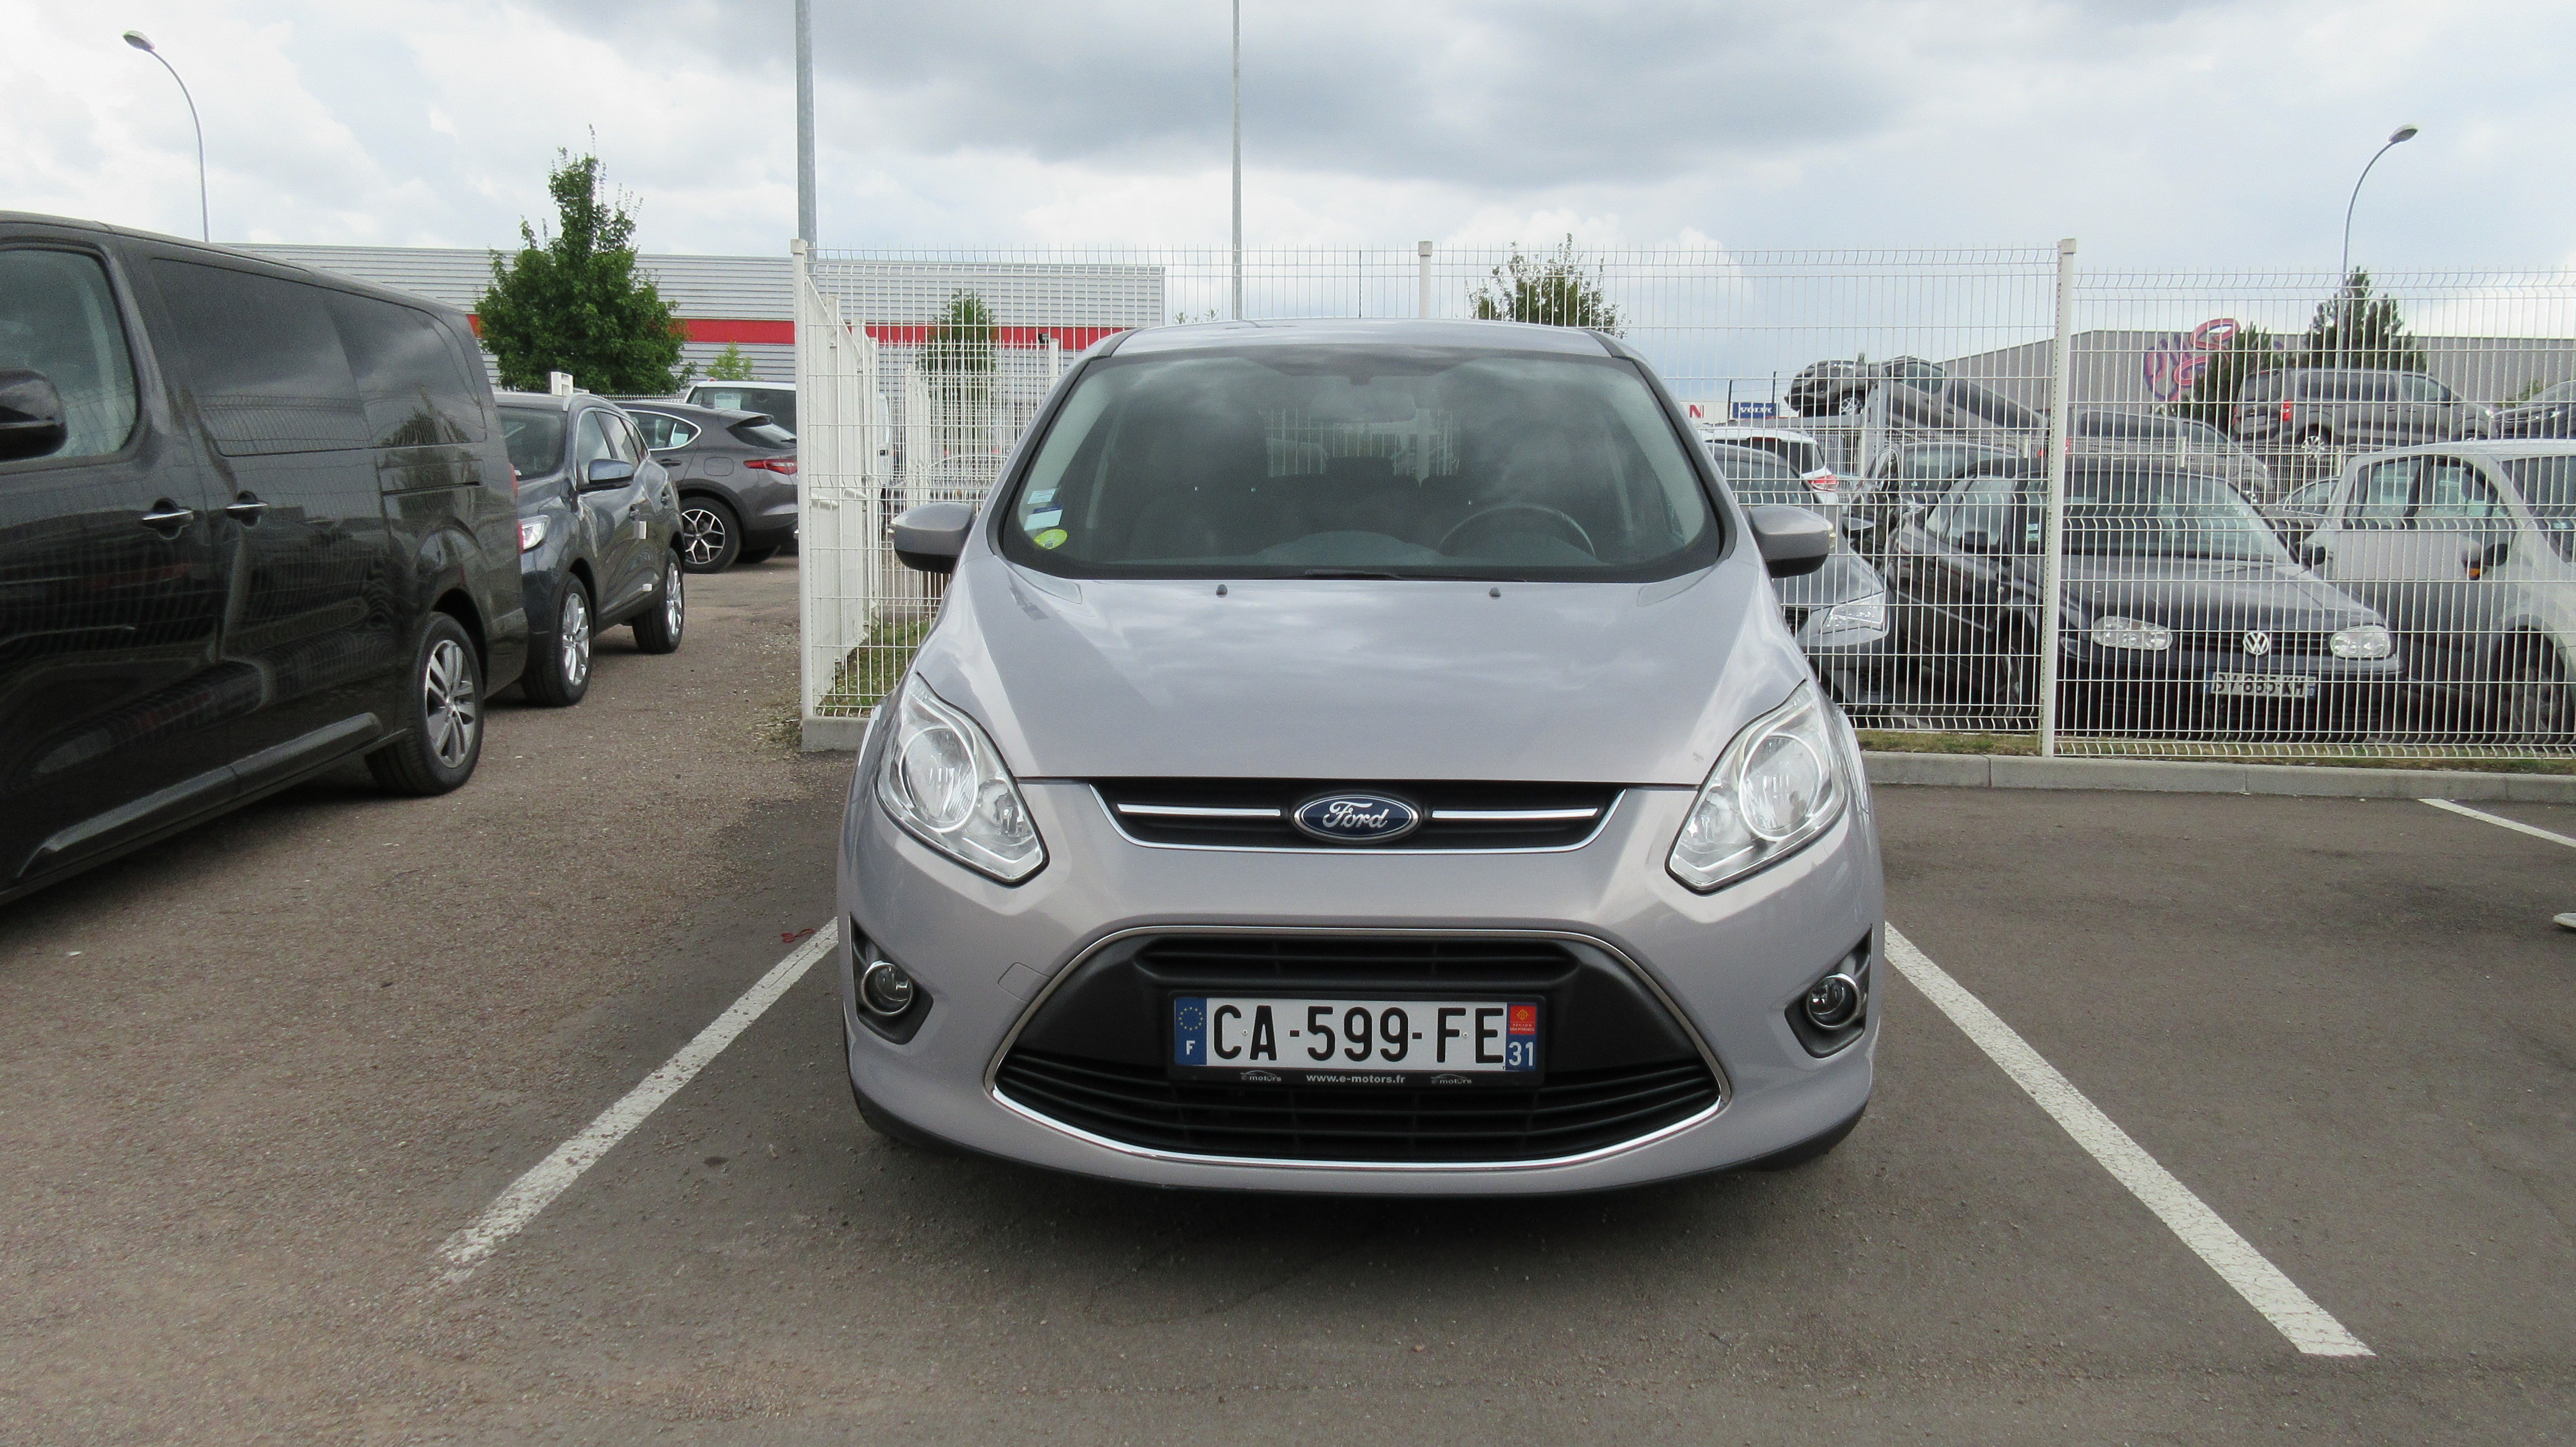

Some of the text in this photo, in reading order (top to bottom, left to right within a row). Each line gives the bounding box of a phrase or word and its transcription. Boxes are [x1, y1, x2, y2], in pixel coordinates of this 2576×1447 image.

[1322, 801, 1390, 828] Ford
[1214, 1004, 1504, 1063] CA-599-FE
[1186, 1040, 1196, 1055] F
[1509, 1042, 1533, 1066] 31
[1306, 1074, 1406, 1084] www.e-motors.fr
